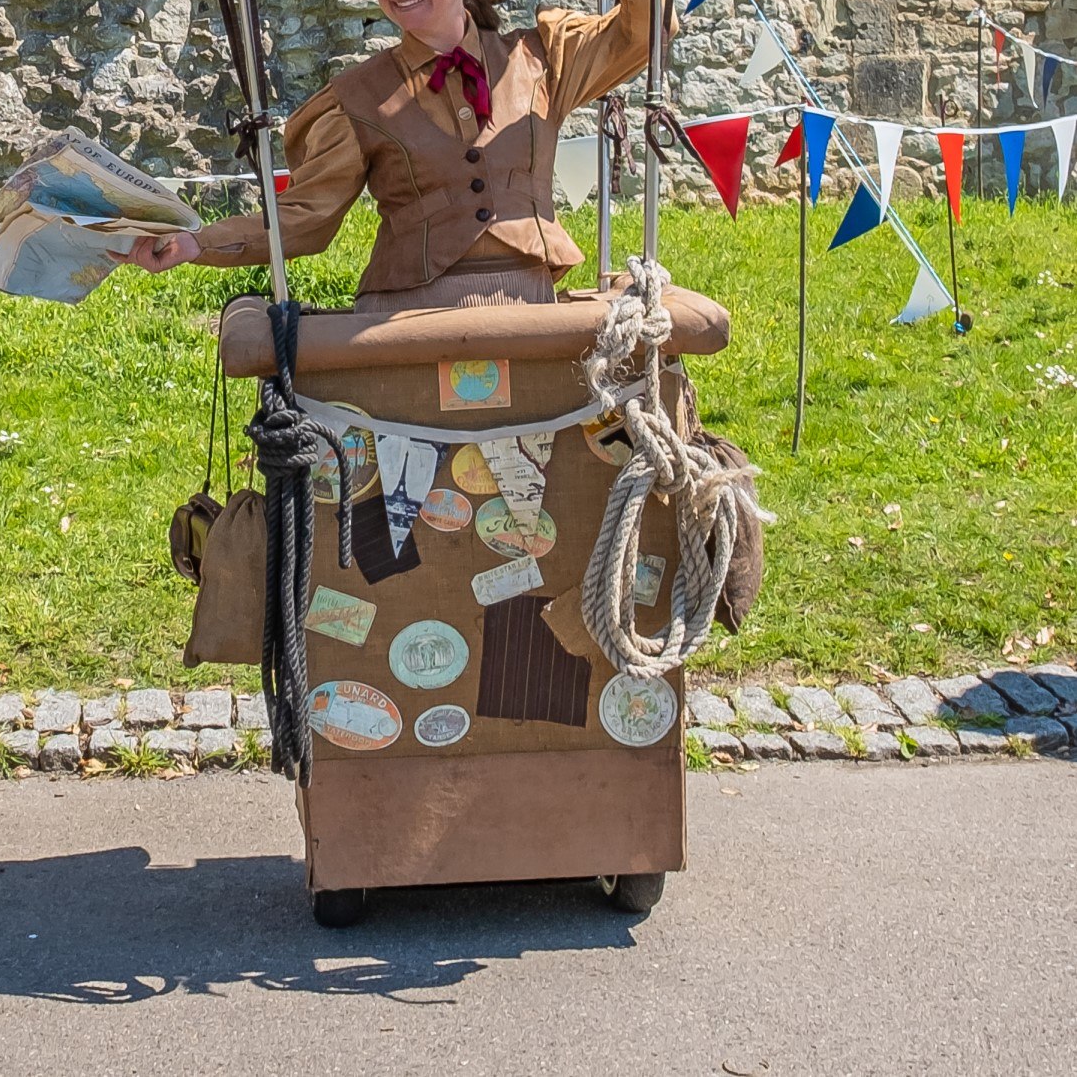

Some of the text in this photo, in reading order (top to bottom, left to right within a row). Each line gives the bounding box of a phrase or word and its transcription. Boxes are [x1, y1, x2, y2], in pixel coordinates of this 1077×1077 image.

[61, 132, 161, 195] AP OF EUROPE
[500, 562, 517, 574] STAR
[334, 683, 388, 709] CUNARD
